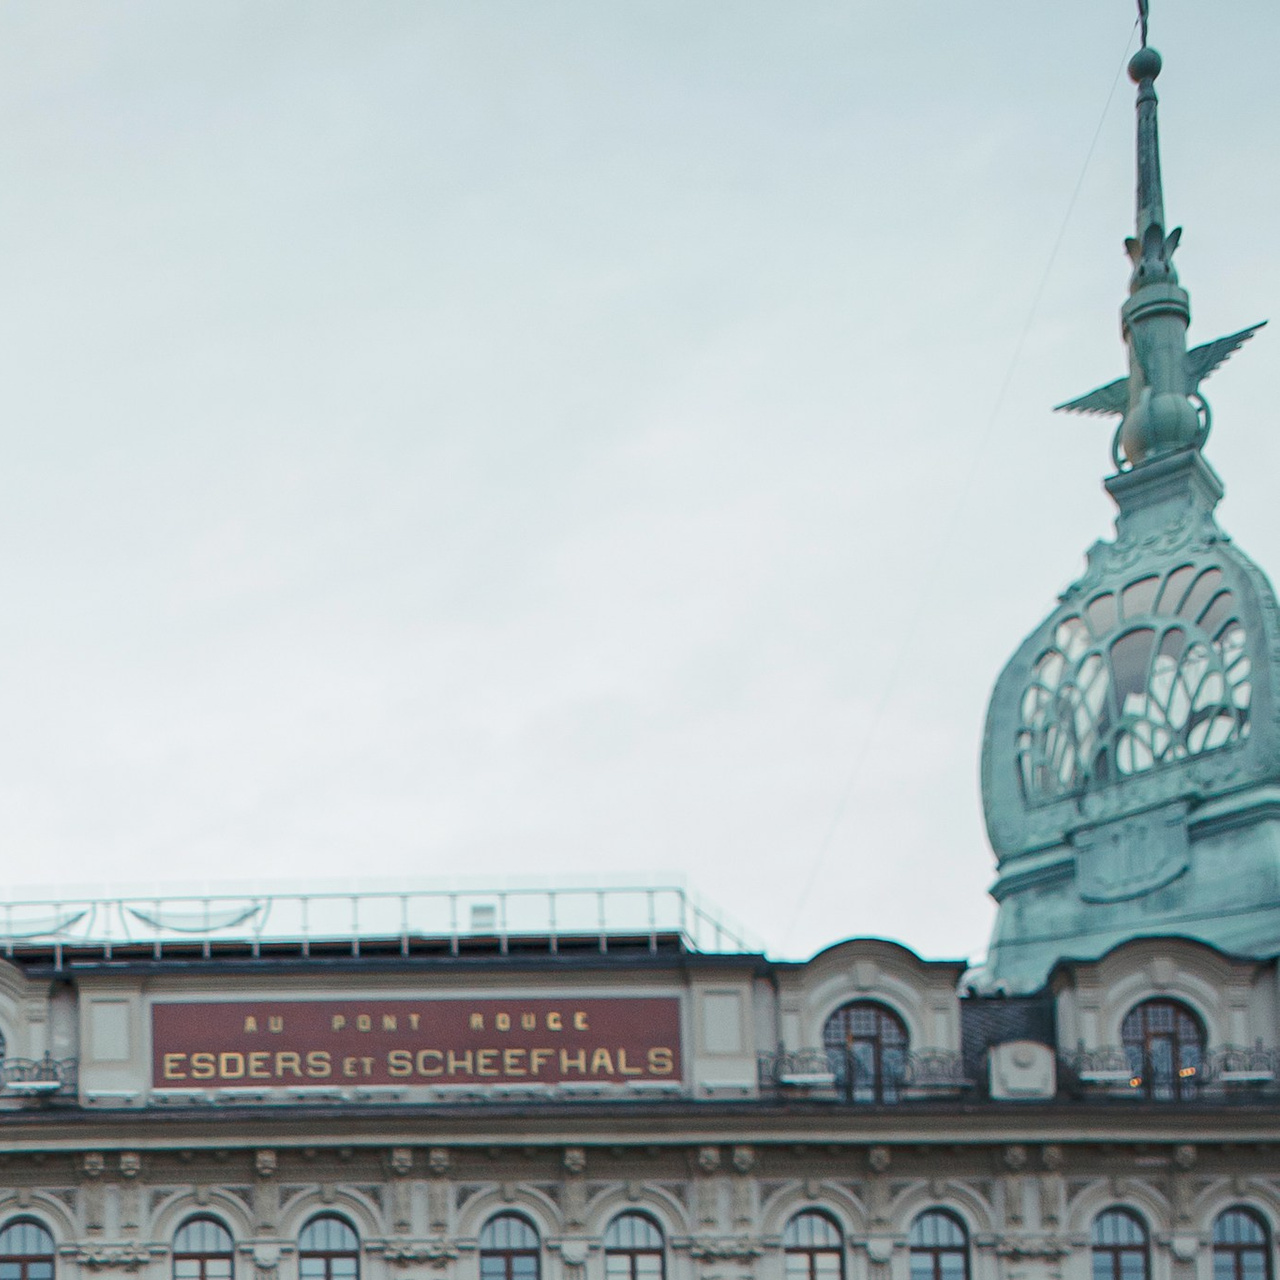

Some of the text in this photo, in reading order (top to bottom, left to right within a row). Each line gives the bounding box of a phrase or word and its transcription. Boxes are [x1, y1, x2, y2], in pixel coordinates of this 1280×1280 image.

[244, 1012, 589, 1033] AU PONT ROUGE
[164, 1047, 674, 1079] ESDERS ET SCHEEFHALS
